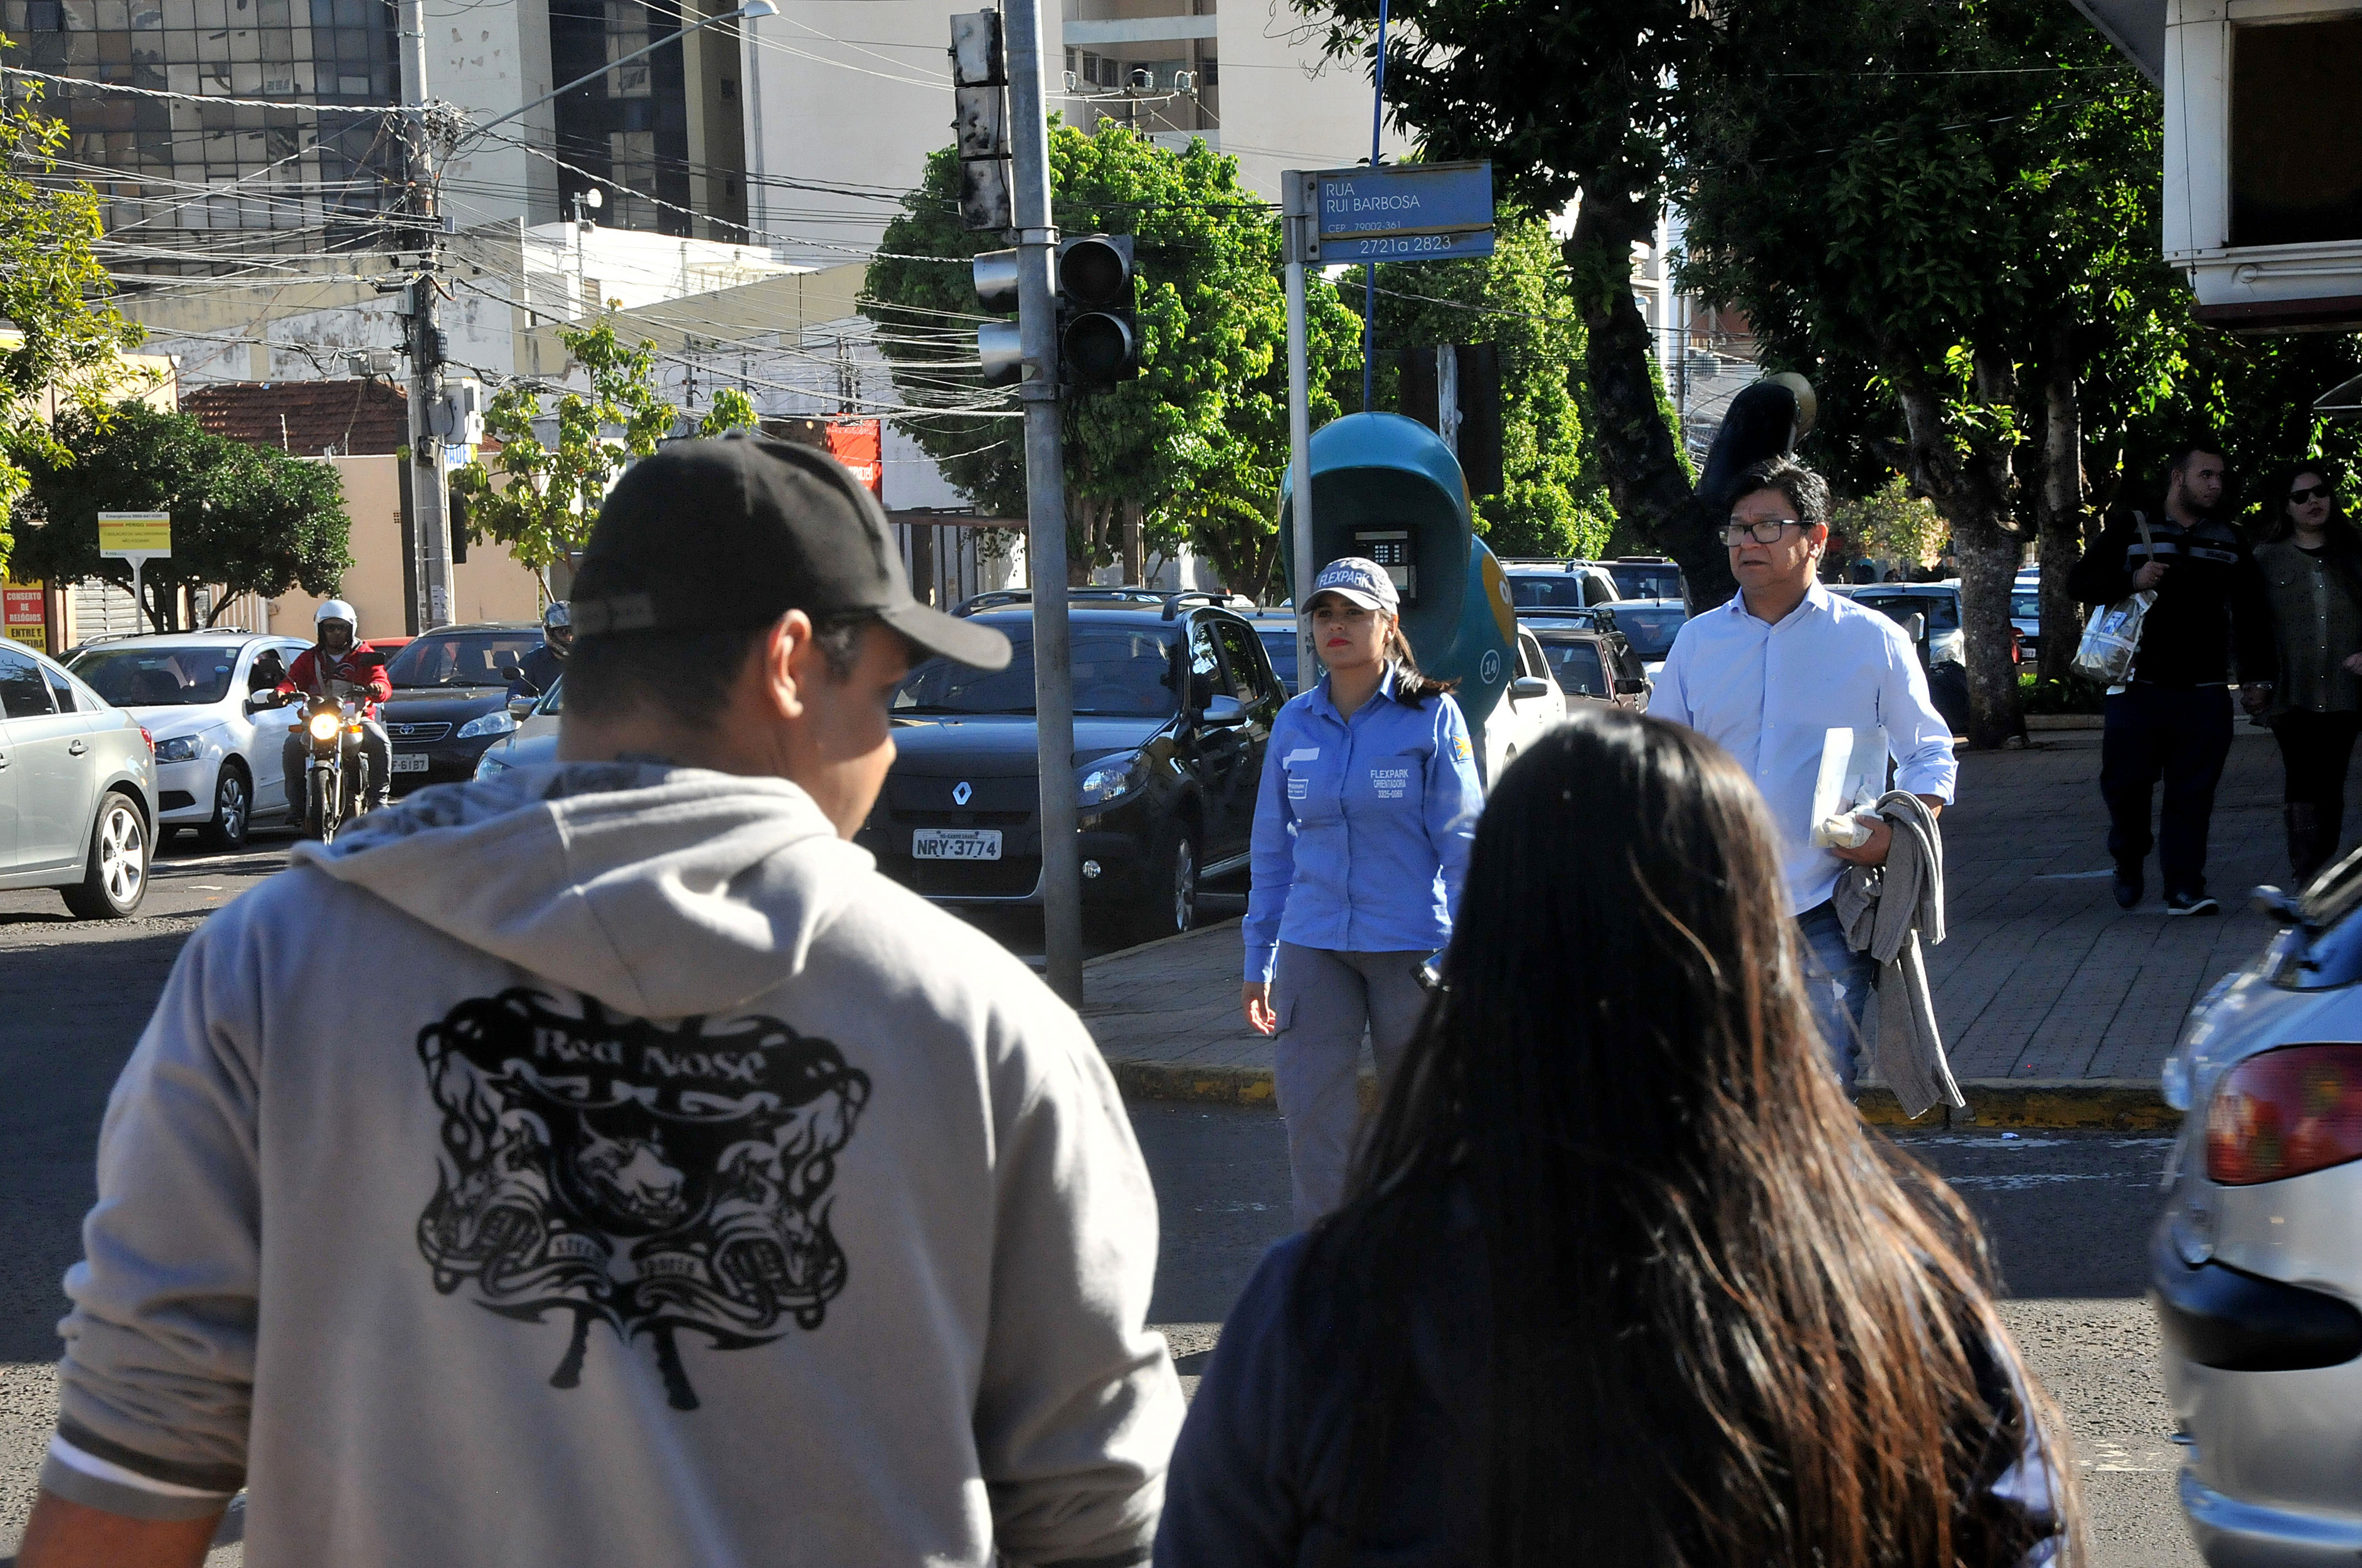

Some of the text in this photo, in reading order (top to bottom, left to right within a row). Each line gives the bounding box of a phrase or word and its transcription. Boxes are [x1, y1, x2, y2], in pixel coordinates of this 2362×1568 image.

[1326, 183, 1355, 197] RUA
[1326, 195, 1420, 213] RUI BARBOSA
[1354, 220, 1401, 231] 79002-361
[1414, 236, 1452, 252] 2823
[1318, 570, 1370, 588] FLEXPARK
[6, 592, 41, 601] CONSERTO
[20, 603, 29, 611] DE
[9, 612, 41, 622] RELÓGIOS
[11, 628, 42, 638] ENTRE E
[1484, 659, 1498, 675] 14
[1370, 769, 1409, 778] FLEXPARK
[534, 1027, 767, 1086] Red Nose
